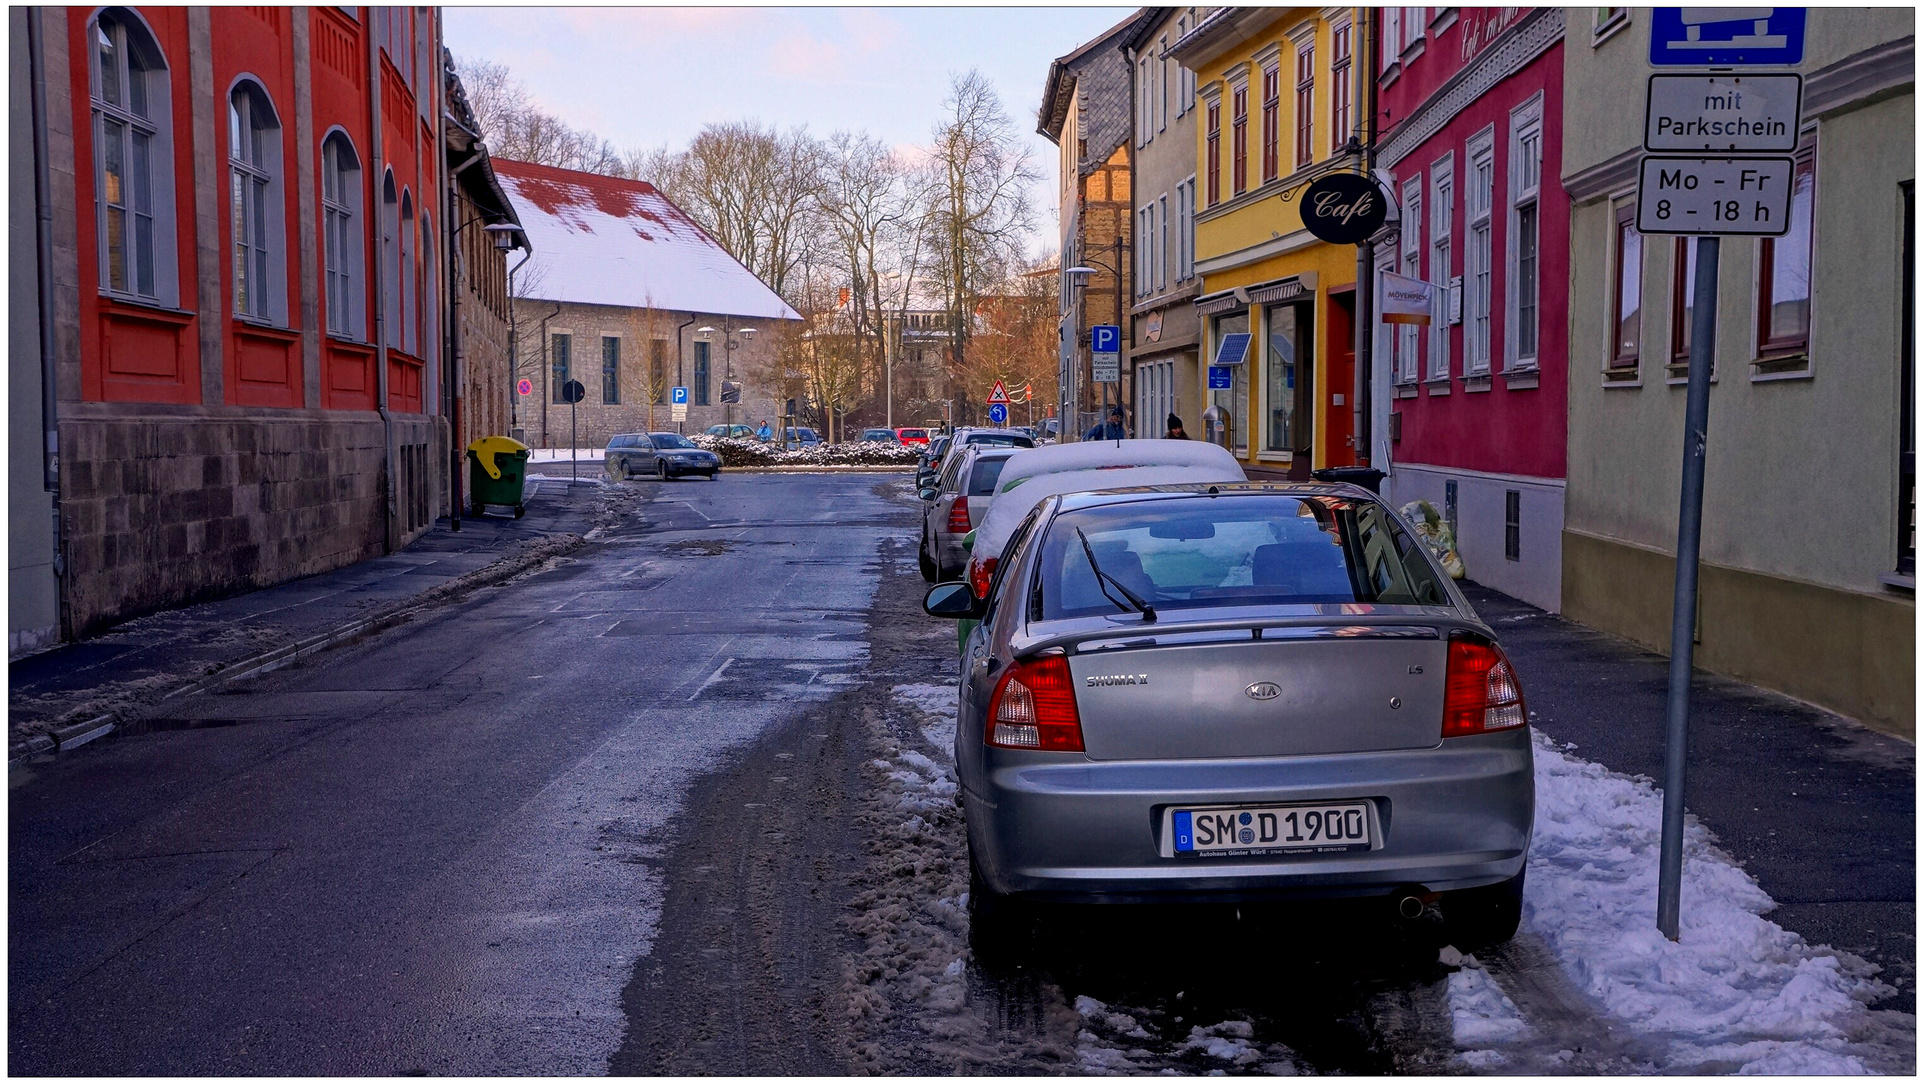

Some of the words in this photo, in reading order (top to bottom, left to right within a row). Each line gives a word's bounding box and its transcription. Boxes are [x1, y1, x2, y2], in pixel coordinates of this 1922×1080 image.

[1704, 91, 1742, 110] mit
[1657, 116, 1786, 136] Parkschein
[1659, 169, 1699, 190] Mo
[1739, 169, 1771, 191] Fr
[1313, 190, 1374, 226] Café
[1655, 199, 1671, 220] 8
[1713, 200, 1740, 221] 18
[1754, 200, 1770, 222] h
[1387, 290, 1428, 300] MÖVENPICK
[1098, 329, 1113, 349] P
[675, 389, 684, 402] P
[1408, 665, 1423, 675] LS
[1086, 674, 1136, 687] SHUMA
[1250, 685, 1277, 697] KIA
[1196, 814, 1237, 845] SM
[1257, 813, 1278, 842] D
[1285, 809, 1363, 842] 1900
[1180, 835, 1188, 844] D
[1199, 850, 1227, 858] Autohaus
